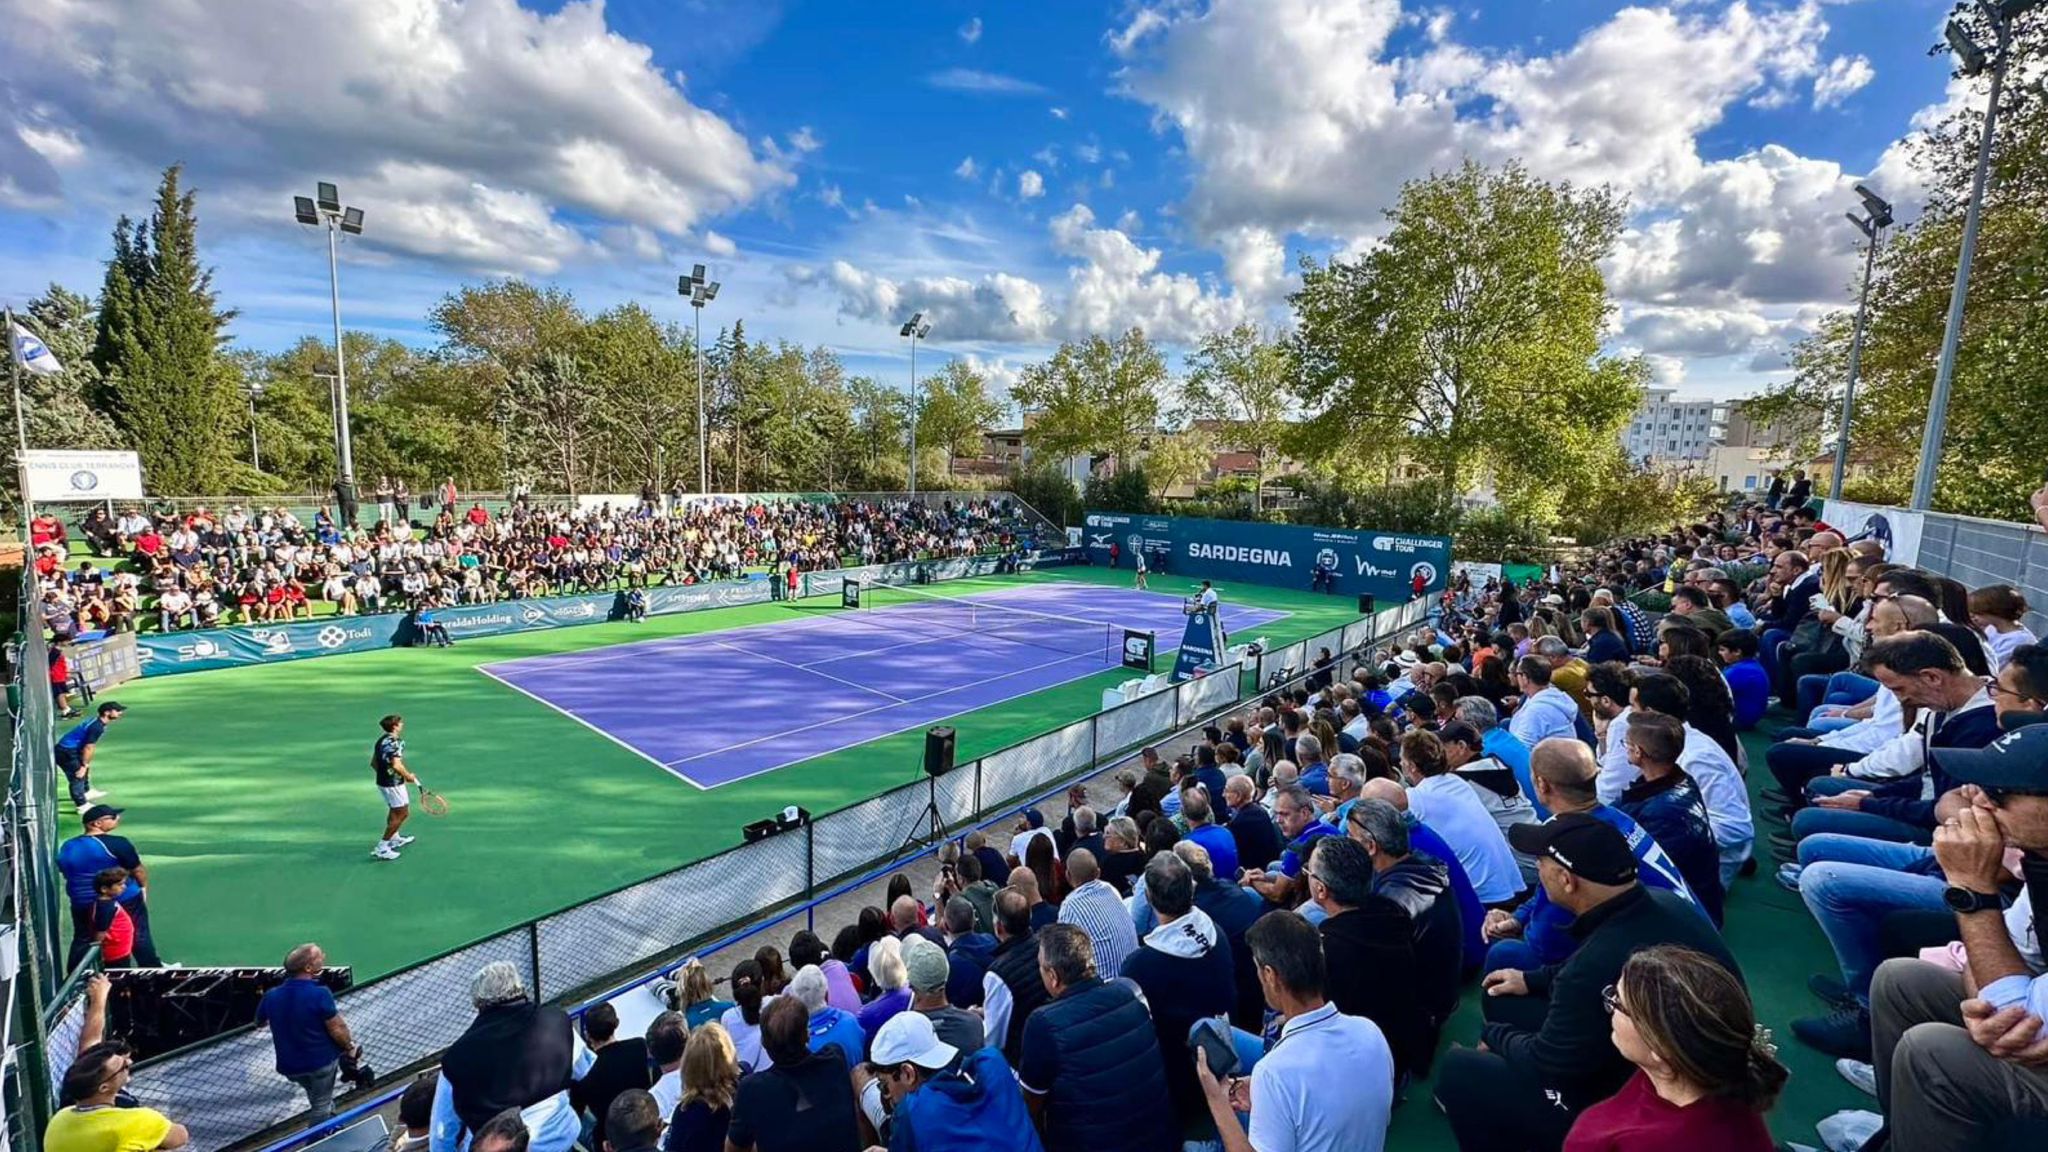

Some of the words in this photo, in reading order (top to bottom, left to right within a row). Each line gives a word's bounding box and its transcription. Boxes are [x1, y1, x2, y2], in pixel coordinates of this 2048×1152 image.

[1395, 537, 1443, 549] CHALLENGER
[1395, 545, 1415, 553] TOUR
[1188, 542, 1292, 567] SARDEGNA
[346, 628, 372, 640] Todi
